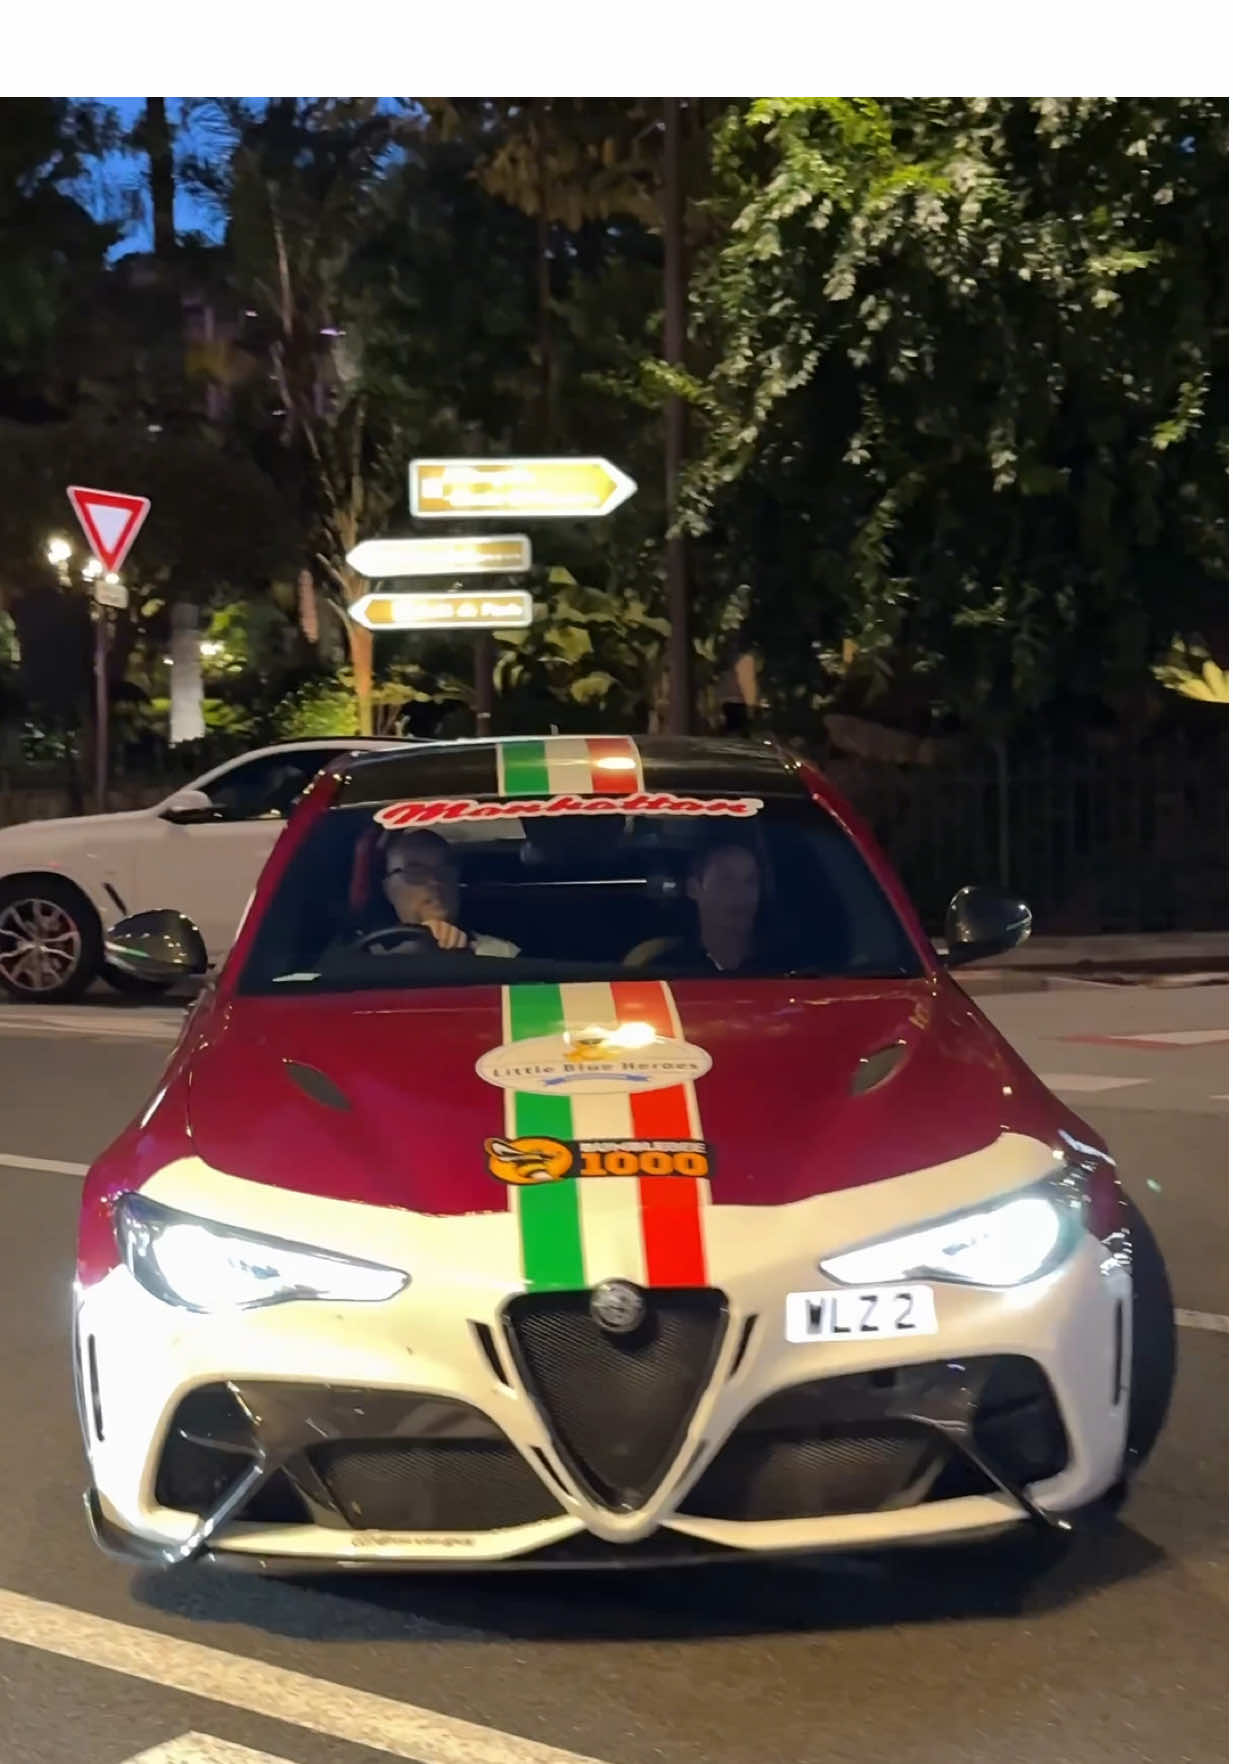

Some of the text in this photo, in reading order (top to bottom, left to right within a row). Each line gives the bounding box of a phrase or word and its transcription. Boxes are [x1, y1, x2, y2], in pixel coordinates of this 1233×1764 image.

[492, 1060, 700, 1078] Little Blue Heroes
[580, 1151, 708, 1177] 1000
